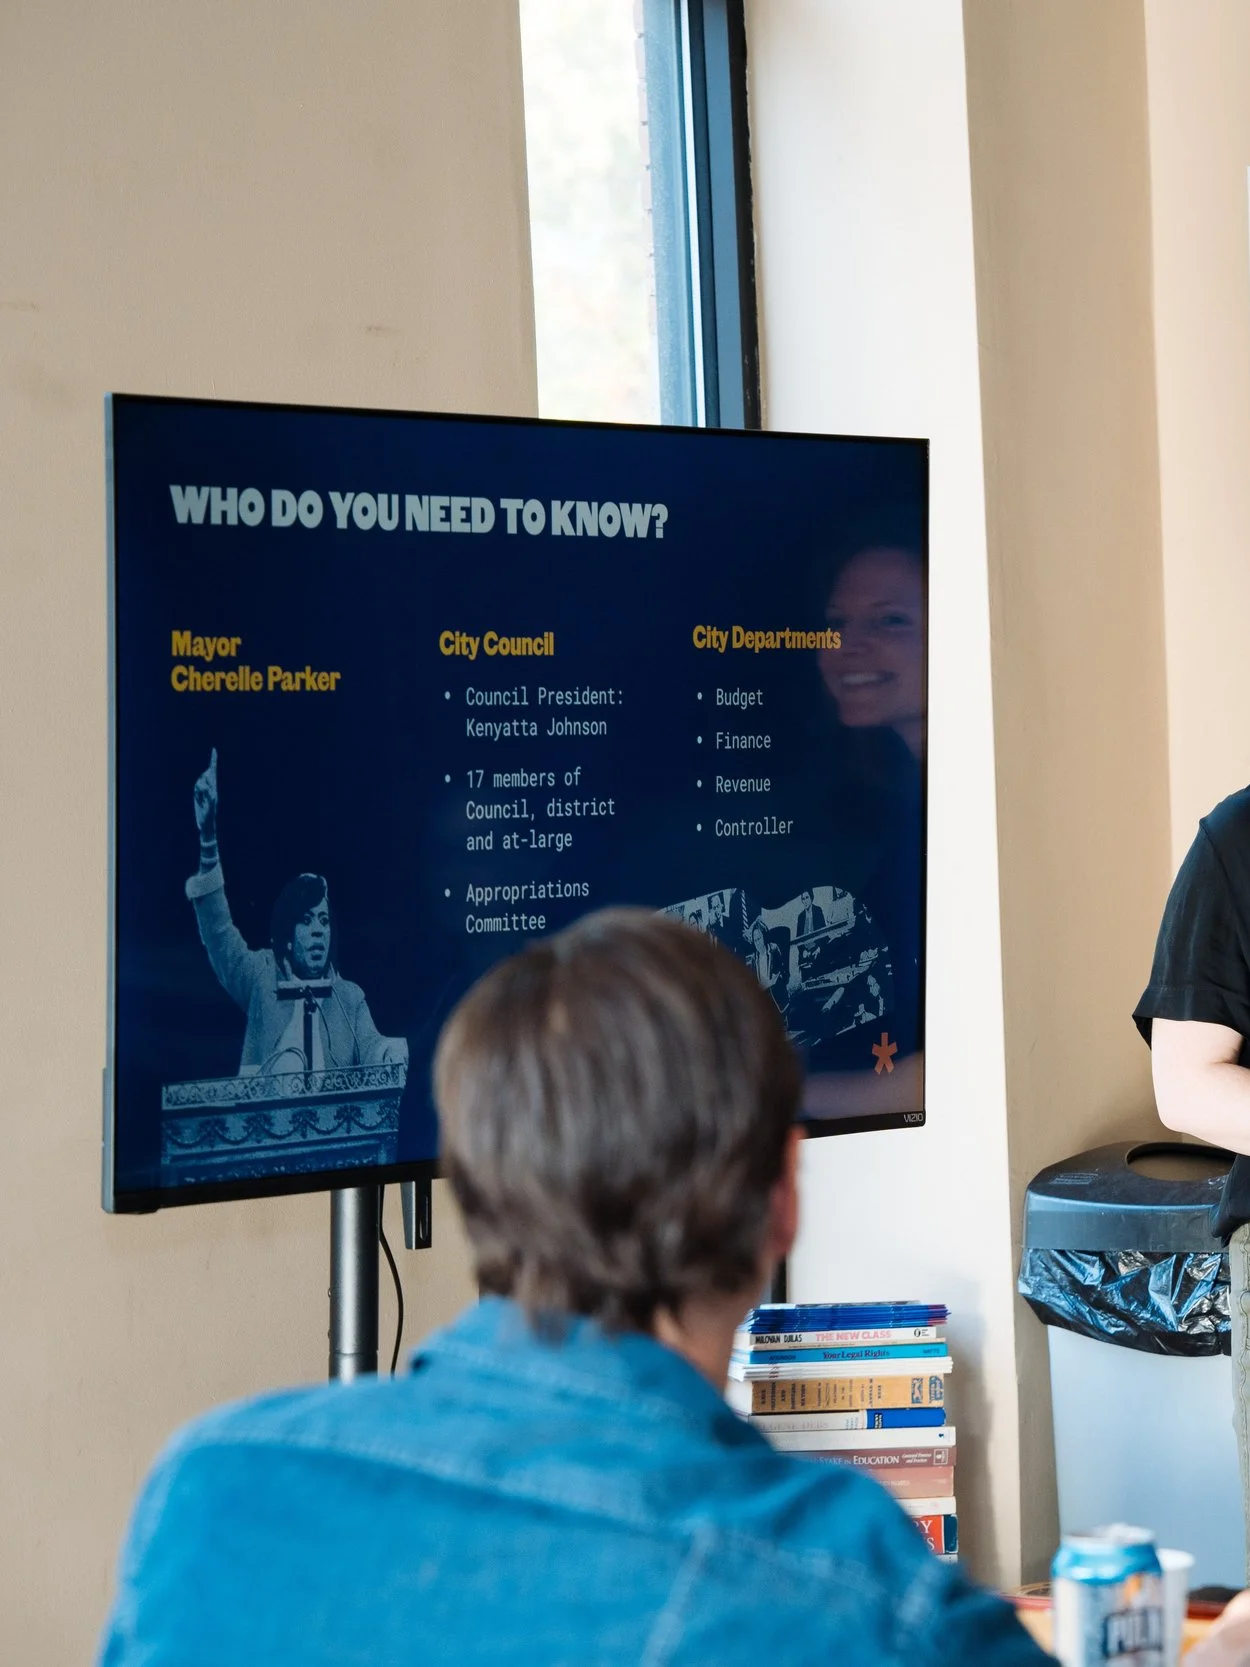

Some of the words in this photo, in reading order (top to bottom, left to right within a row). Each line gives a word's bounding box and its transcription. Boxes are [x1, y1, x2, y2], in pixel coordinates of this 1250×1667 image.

[169, 485, 266, 528] WHO
[270, 489, 324, 528] DO
[328, 490, 399, 531] YOU
[405, 494, 496, 534] NEED
[500, 498, 546, 536] TO
[551, 500, 669, 539] KNOW?
[171, 630, 242, 661] Mayor
[439, 630, 480, 660] City
[484, 632, 554, 656] Council
[692, 624, 728, 653] City
[732, 625, 842, 654] Departments
[170, 665, 263, 692] Cherelle
[268, 667, 341, 691] Parker
[466, 686, 529, 706] Council
[538, 686, 624, 706] President:
[716, 688, 764, 708] Budget
[466, 718, 538, 742] Kenyatta
[547, 716, 608, 736] Johnson
[716, 732, 772, 750] Finance
[466, 770, 484, 788] 17
[494, 769, 556, 788] members
[564, 767, 582, 786] of
[716, 776, 772, 794] Revenue
[466, 800, 536, 821] Council,
[546, 798, 616, 818] district
[715, 816, 794, 837] Controller
[466, 832, 493, 850] and
[502, 830, 572, 852] at-large
[466, 880, 590, 907] Appropriations
[466, 914, 546, 934] Committee
[816, 1333, 834, 1341] THE
[836, 1332, 860, 1340] NEW
[861, 1330, 892, 1340] CLASS
[823, 1351, 840, 1360] Your
[842, 1350, 862, 1360] Legal
[864, 1349, 890, 1358] Rights
[853, 1456, 900, 1465] EDUCATION
